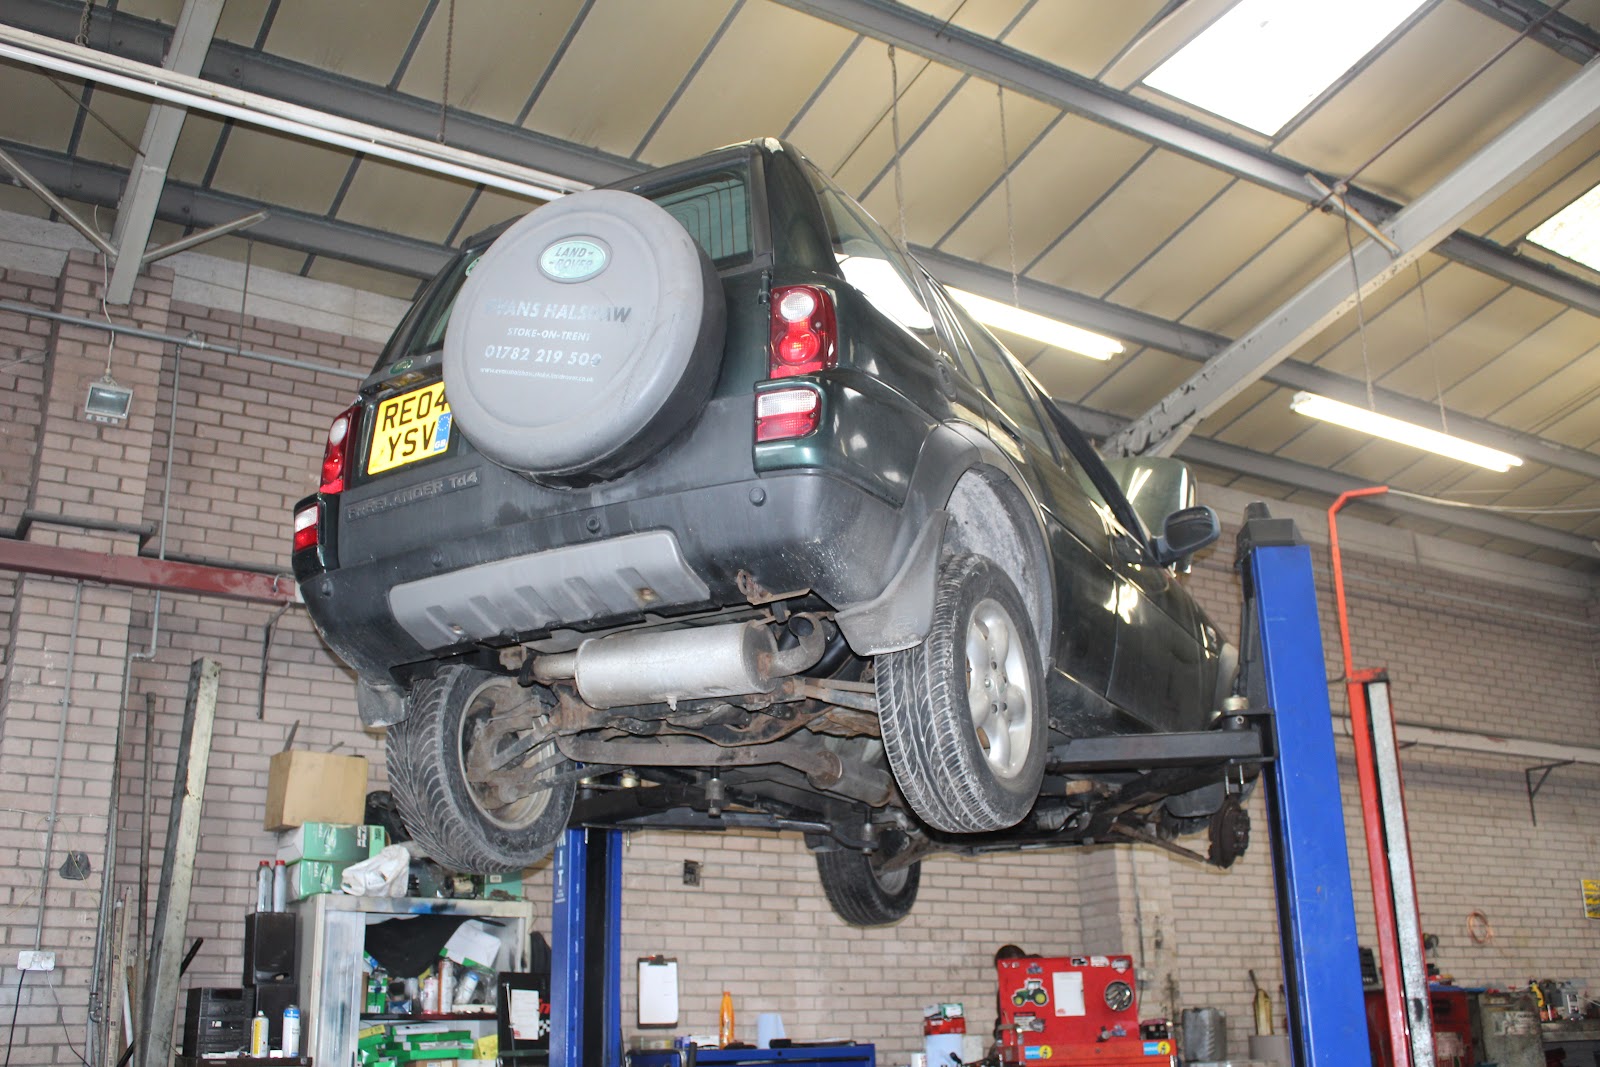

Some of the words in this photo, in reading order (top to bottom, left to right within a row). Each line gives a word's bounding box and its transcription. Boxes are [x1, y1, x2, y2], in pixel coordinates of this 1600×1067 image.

[484, 344, 531, 361] 01782
[534, 348, 563, 364] 219
[382, 390, 449, 432] RE04
[388, 421, 436, 462] YSV
[434, 439, 446, 449] GB
[449, 471, 478, 489] Td4
